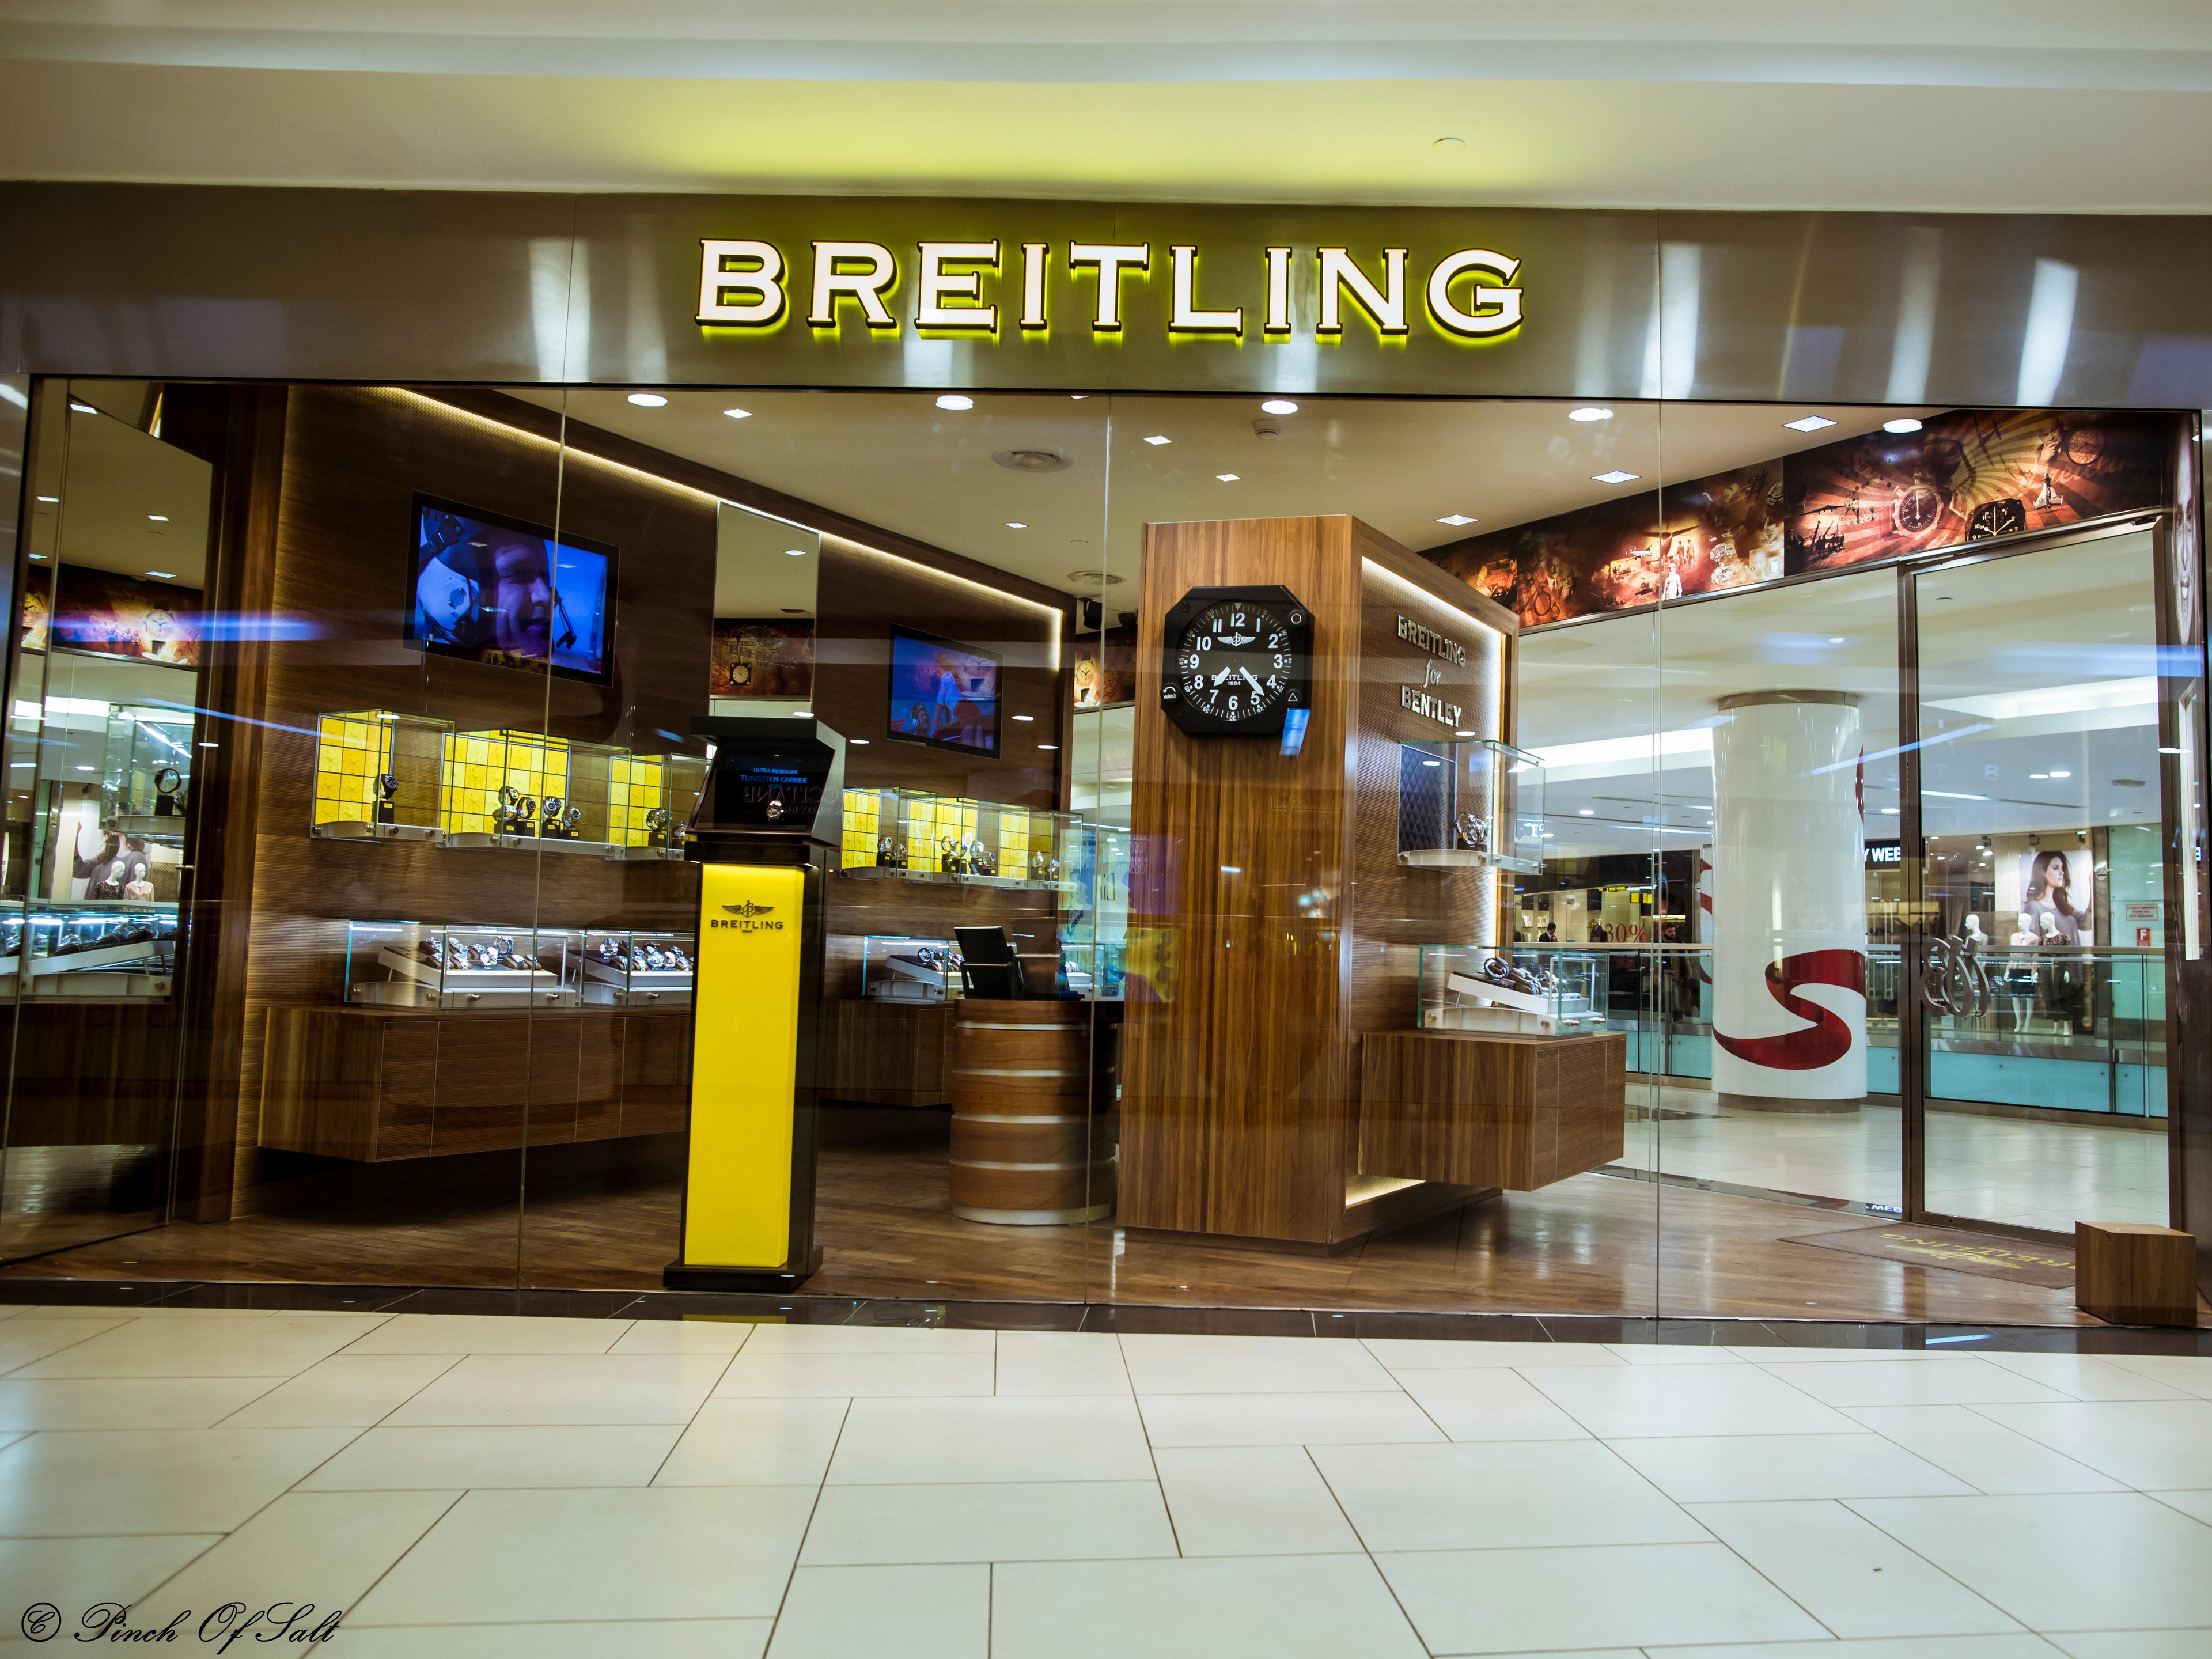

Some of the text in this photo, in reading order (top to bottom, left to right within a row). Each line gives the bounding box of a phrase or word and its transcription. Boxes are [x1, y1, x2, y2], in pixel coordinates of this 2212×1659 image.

[695, 238, 1523, 338] BREITLING
[1213, 619, 1222, 632] 11
[1230, 612, 1245, 627] 12
[1256, 618, 1260, 632] 1
[1197, 636, 1211, 651] 10
[1268, 634, 1278, 649] 2
[1397, 615, 1467, 668] BREITLING
[1190, 654, 1199, 669] 9
[1273, 654, 1283, 669] 3
[1422, 658, 1442, 688] for
[1194, 675, 1203, 689] 8
[1266, 675, 1277, 689] 4
[1210, 690, 1219, 704] 7
[1228, 696, 1238, 710] 6
[1250, 691, 1260, 705] 5
[1402, 685, 1462, 728] BENTLEY
[740, 775, 779, 783] TUNGSTEN
[711, 919, 783, 929] BREITLING
[1605, 922, 1649, 943] 30%
[2140, 929, 2147, 940] F
